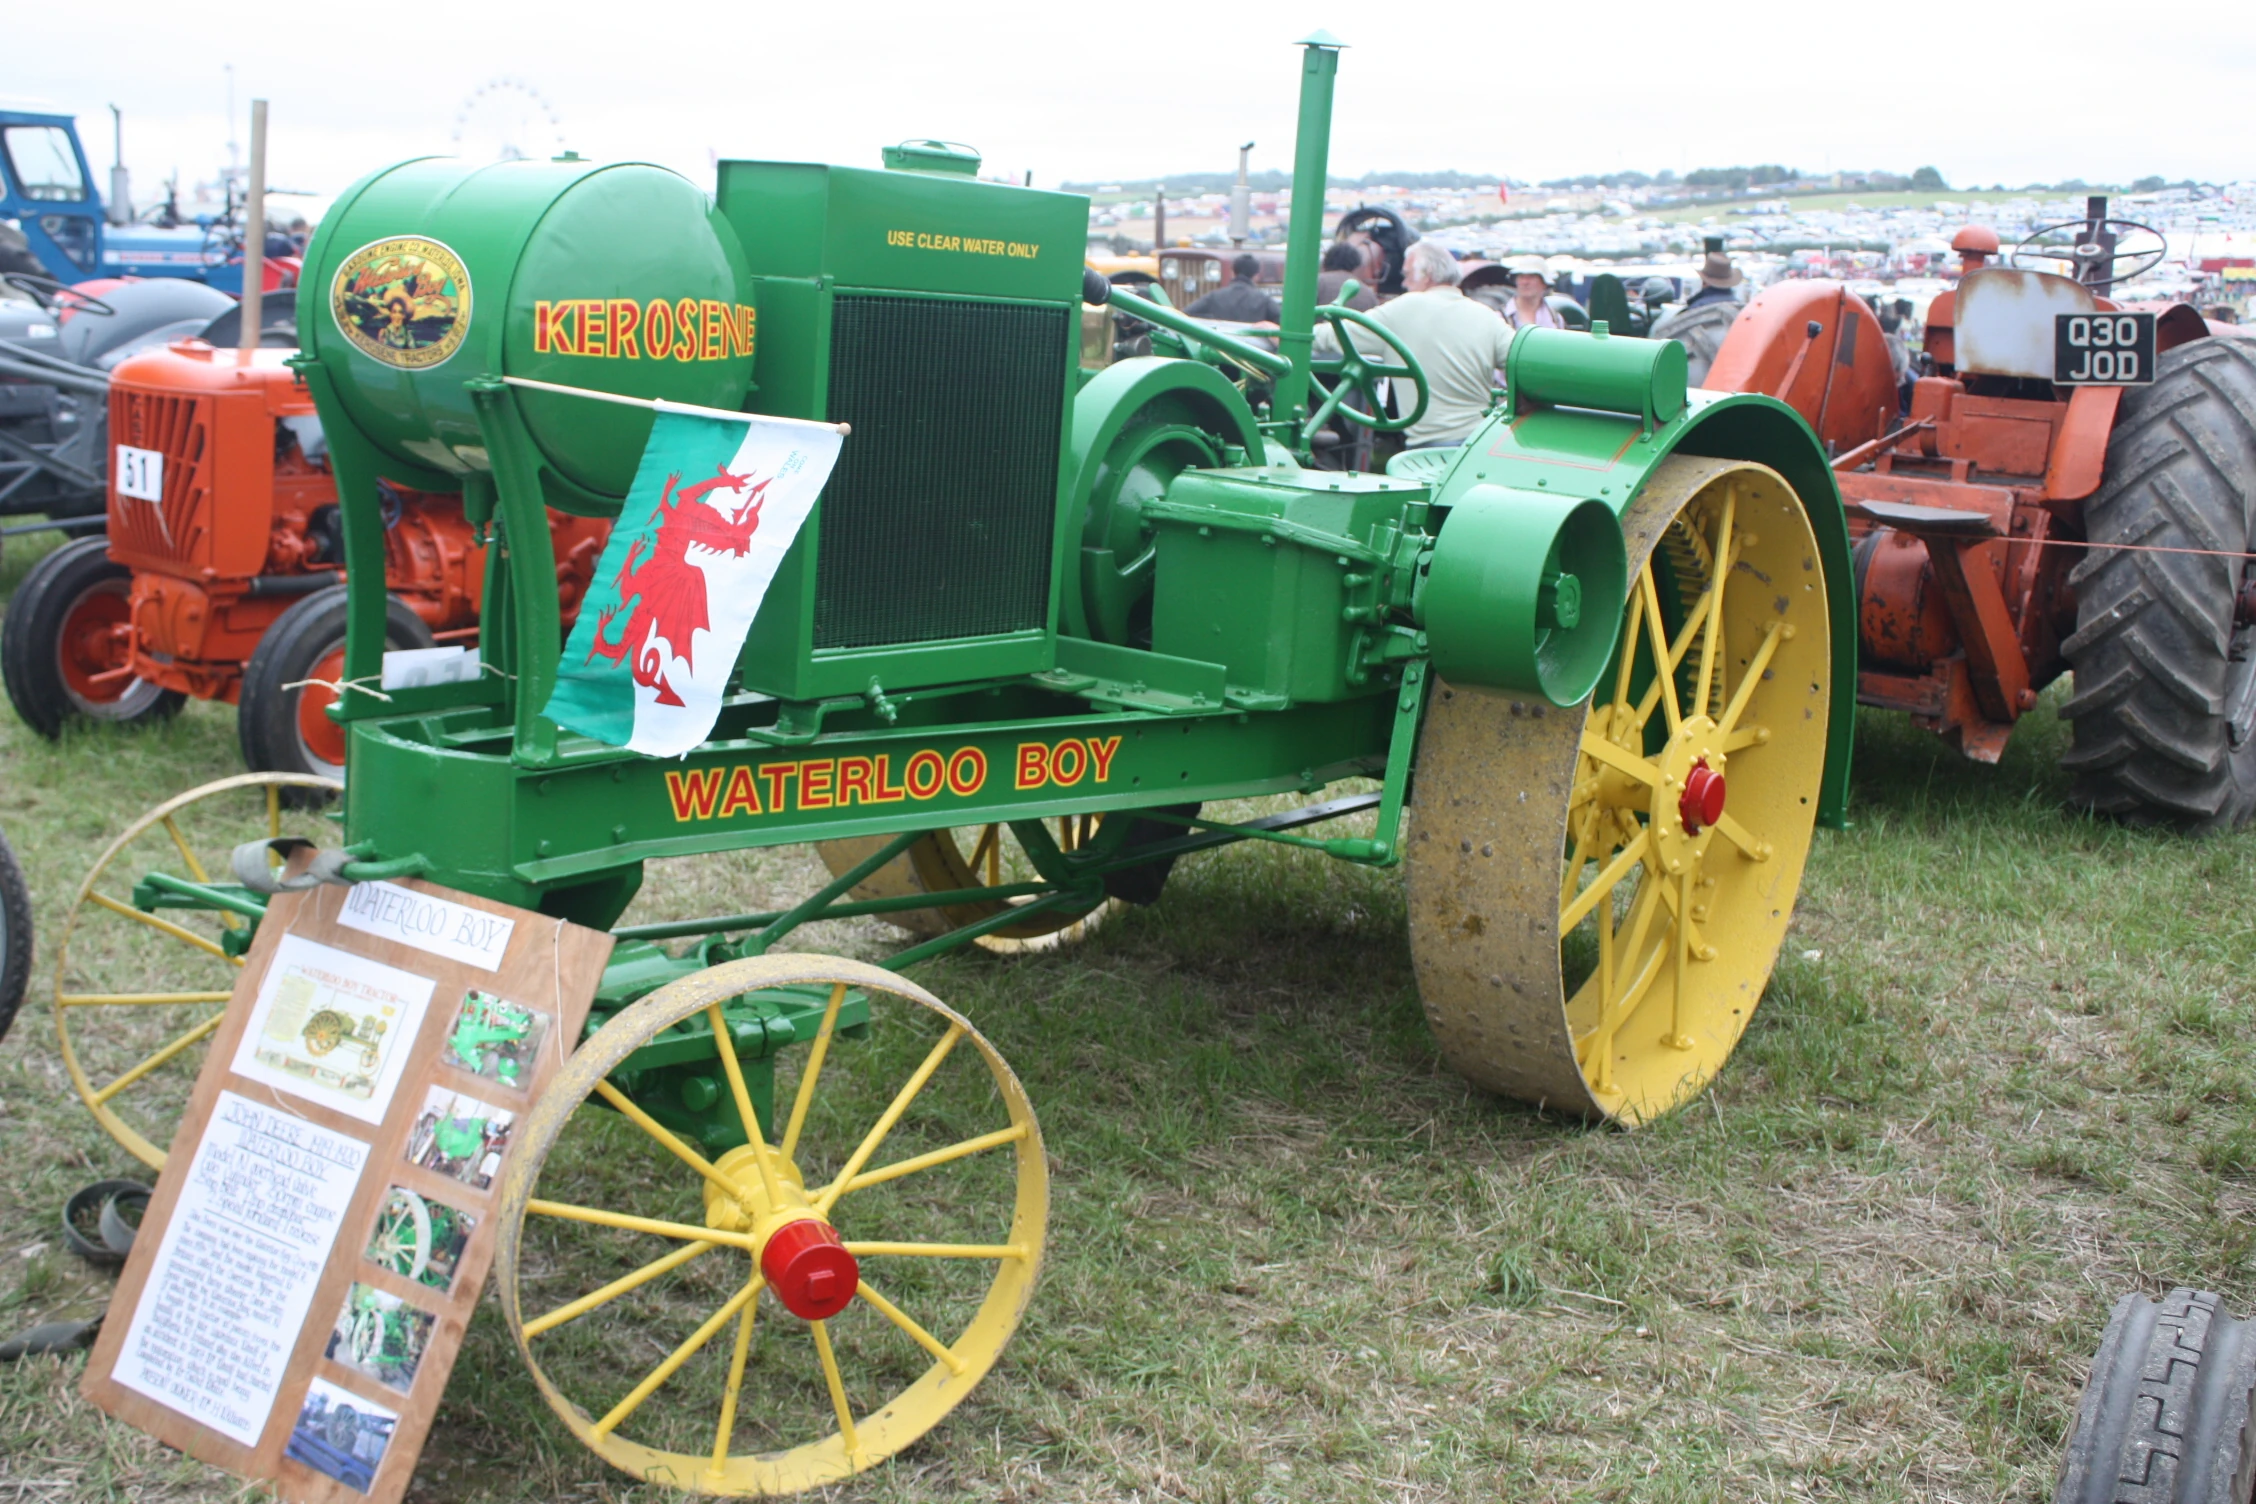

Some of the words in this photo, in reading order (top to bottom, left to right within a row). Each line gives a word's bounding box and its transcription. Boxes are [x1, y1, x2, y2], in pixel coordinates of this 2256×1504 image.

[380, 242, 407, 257] ENGINE
[421, 243, 454, 271] WATERLOO
[888, 230, 915, 247] USE
[917, 233, 960, 251] CLEAR
[963, 238, 1005, 255] WATER
[1007, 243, 1039, 259] ONLY
[353, 256, 426, 294] Waterloo
[412, 272, 453, 316] Boy
[534, 298, 757, 362] KEROSENE
[2068, 317, 2138, 347] Q30
[399, 345, 444, 364] TRACTORS
[2069, 351, 2139, 380] JOD
[126, 452, 148, 493] 51
[777, 450, 799, 479] WALES
[665, 746, 987, 823] WATERLOO
[1015, 736, 1122, 789] BOY
[348, 881, 448, 936] WATERLOO
[450, 912, 509, 952] BOY
